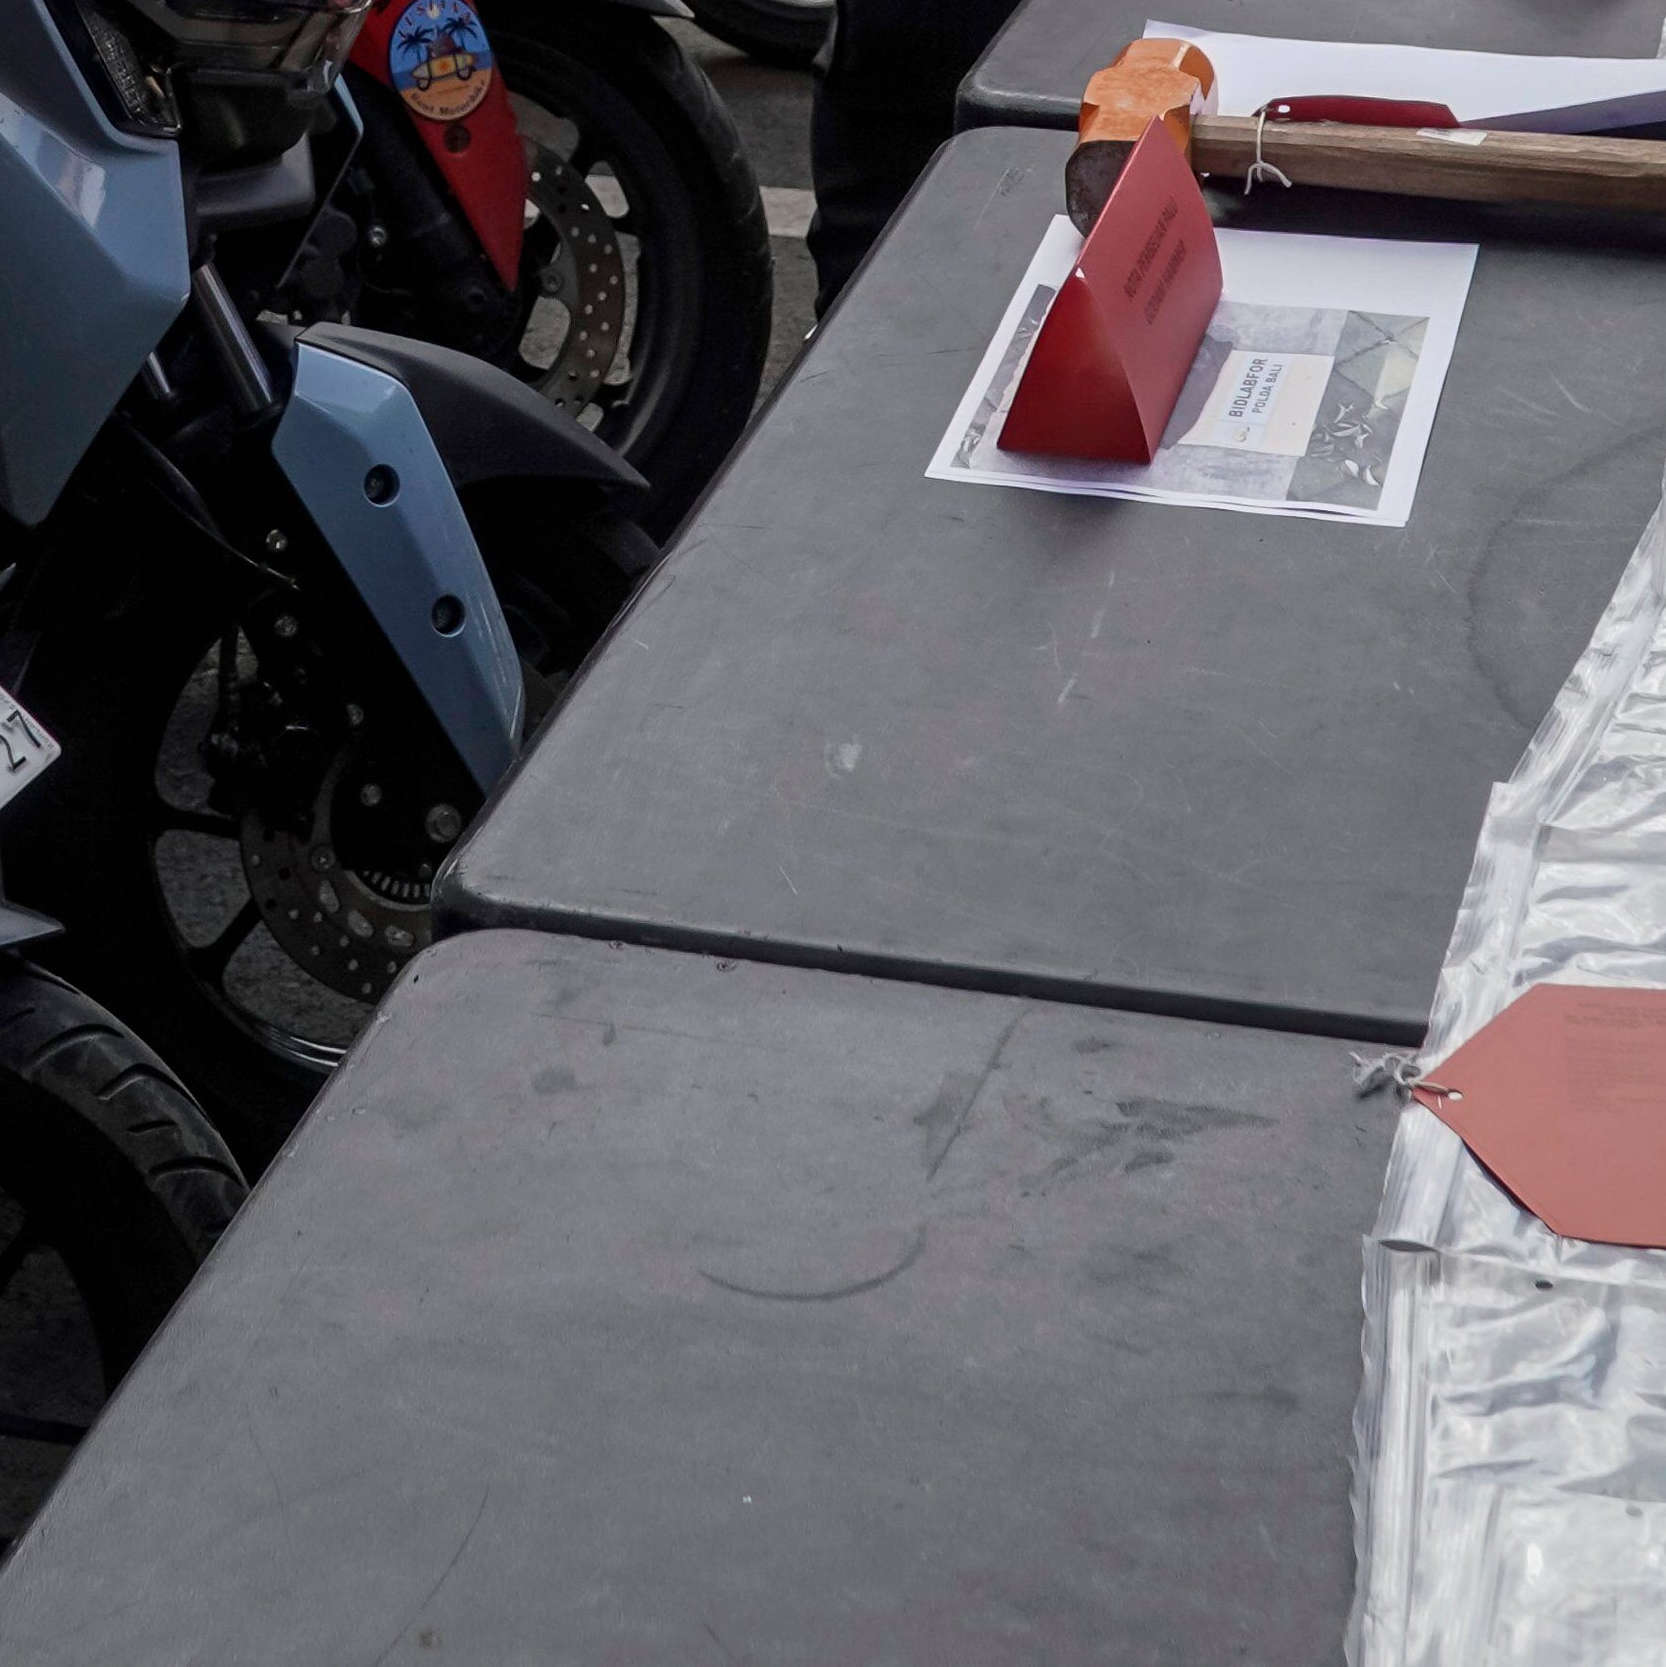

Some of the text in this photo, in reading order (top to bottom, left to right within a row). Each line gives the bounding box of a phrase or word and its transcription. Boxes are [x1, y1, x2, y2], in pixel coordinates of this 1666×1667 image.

[1229, 358, 1268, 417] BIDLABFOR
[1252, 364, 1284, 414] POLDA BALI
